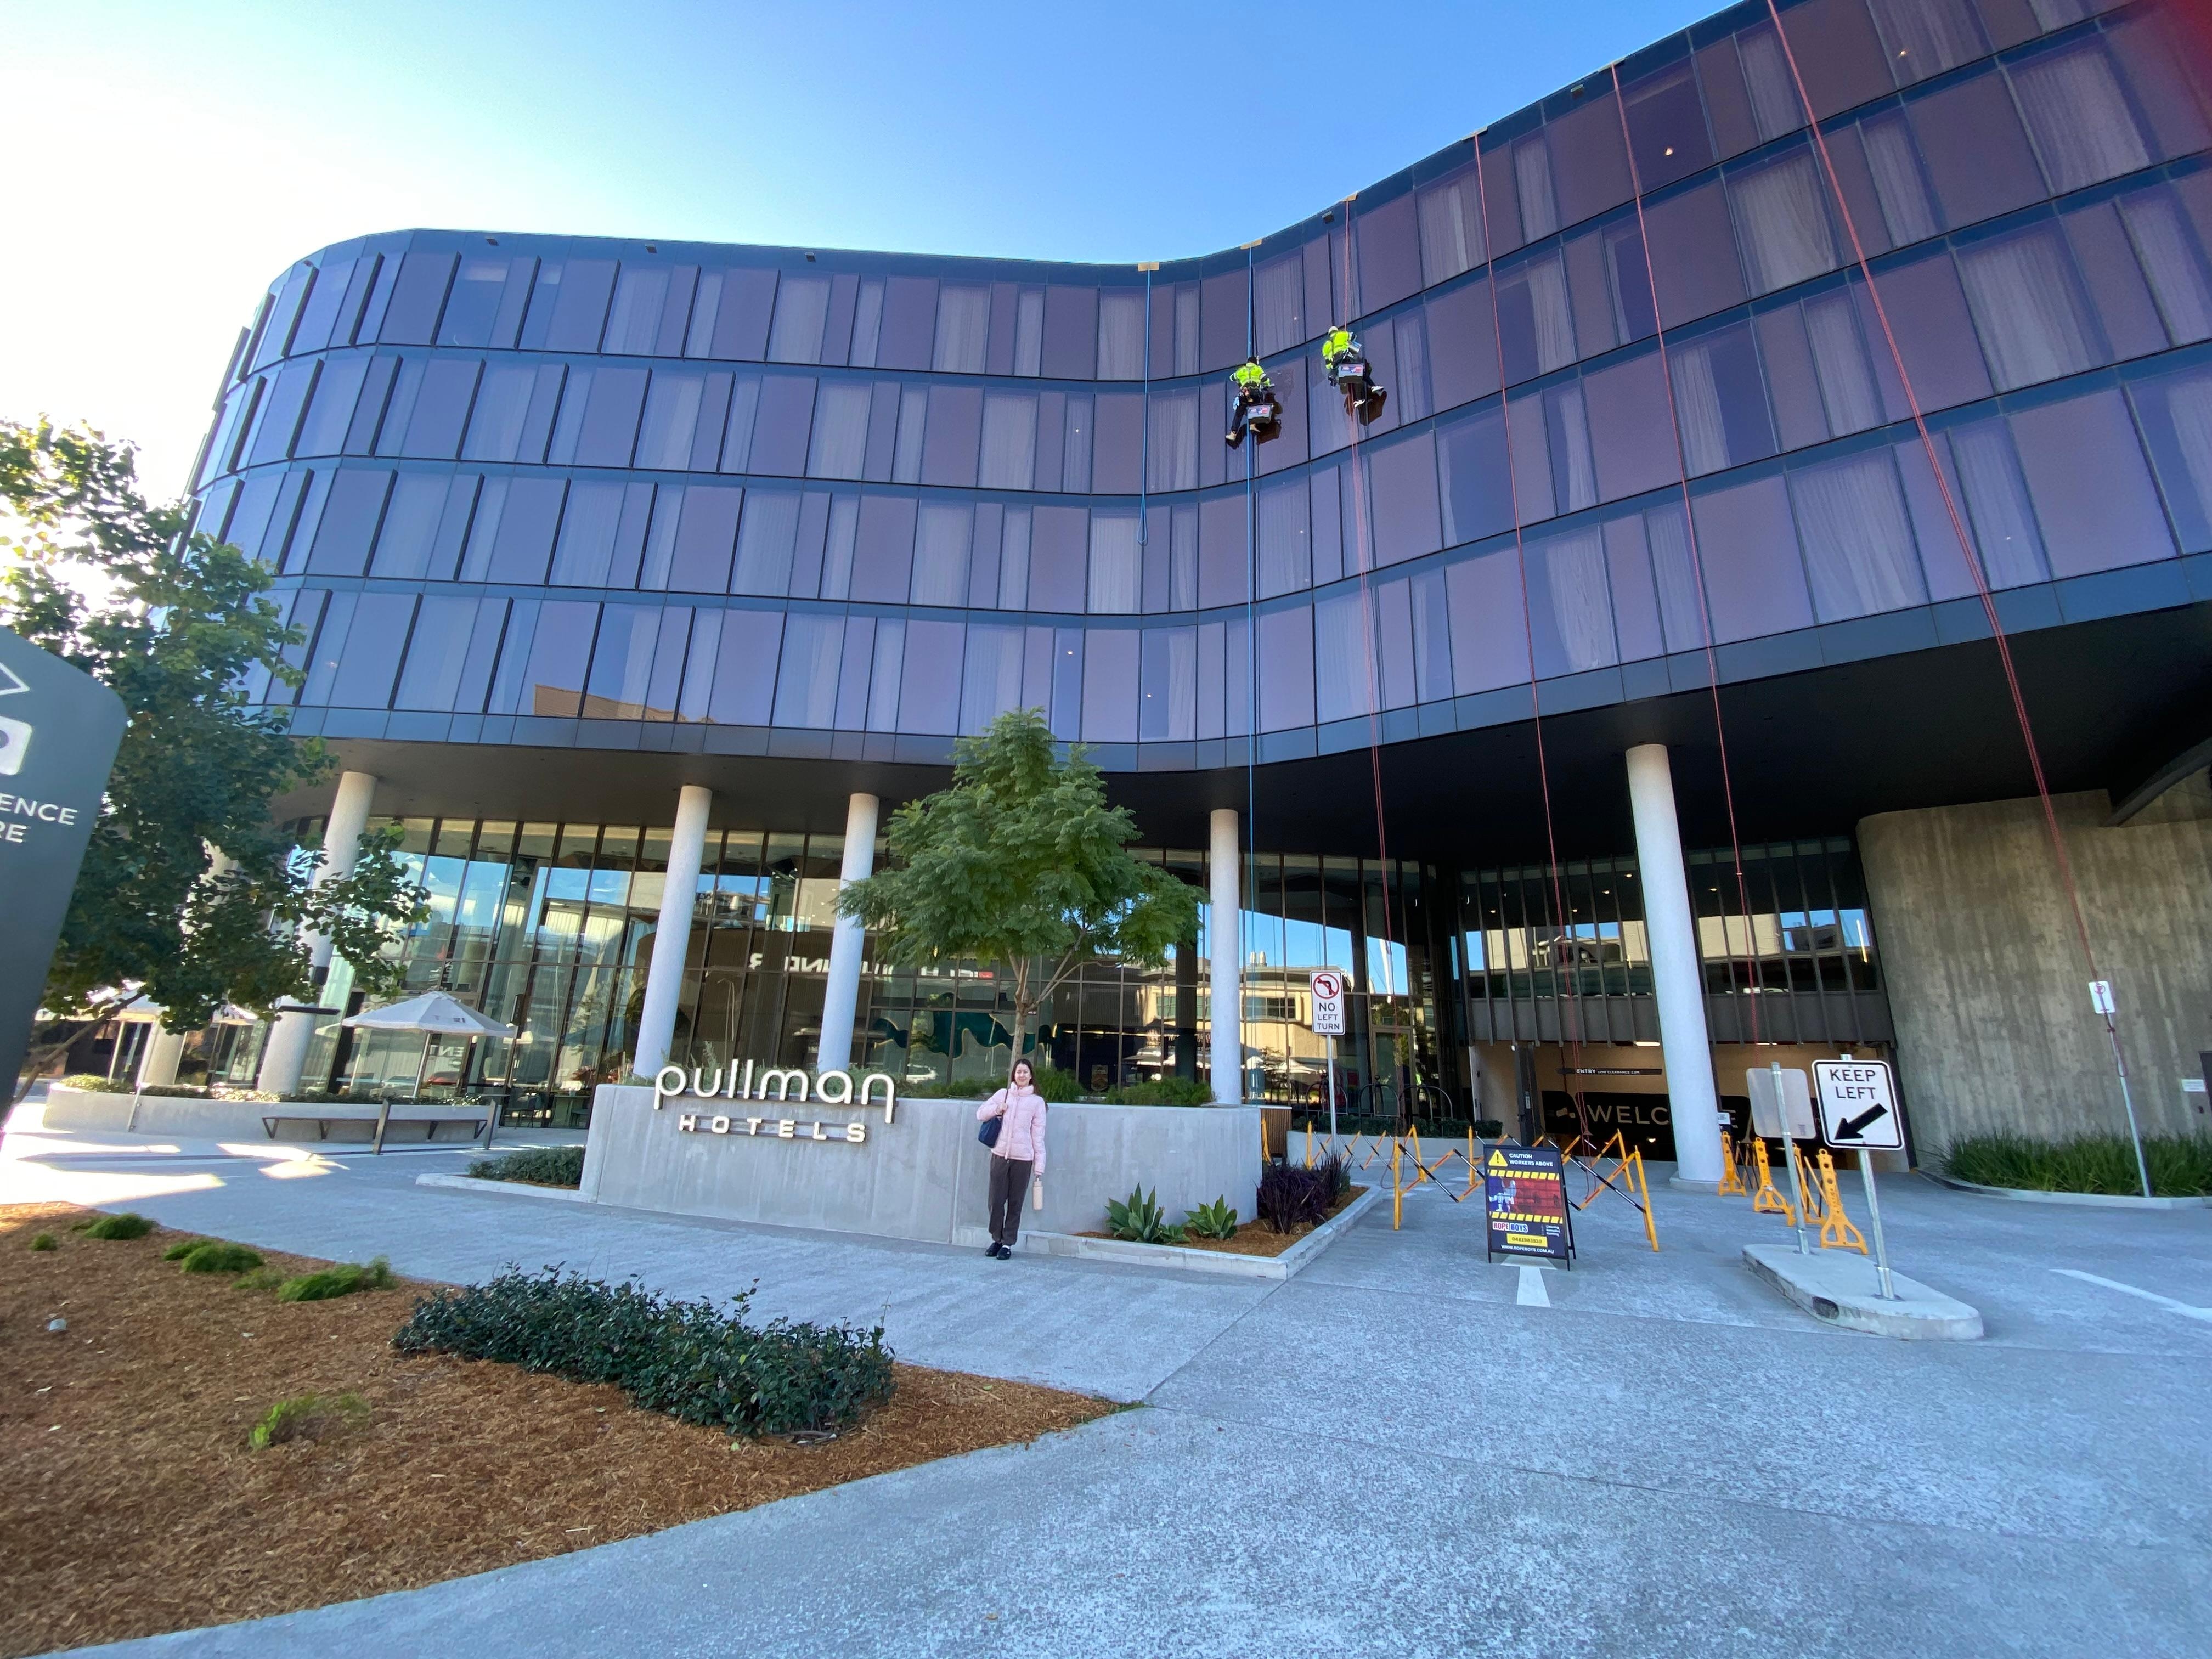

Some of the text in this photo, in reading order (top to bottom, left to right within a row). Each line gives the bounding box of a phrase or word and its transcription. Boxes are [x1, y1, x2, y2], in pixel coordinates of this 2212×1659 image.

[1319, 1002, 1335, 1012] NO
[1829, 1069, 1876, 1082] KEEP
[653, 1058, 896, 1124] pullman
[1835, 1086, 1876, 1099] LEFT
[679, 1115, 866, 1143] HOTELS
[1510, 1223, 1527, 1232] BOYS
